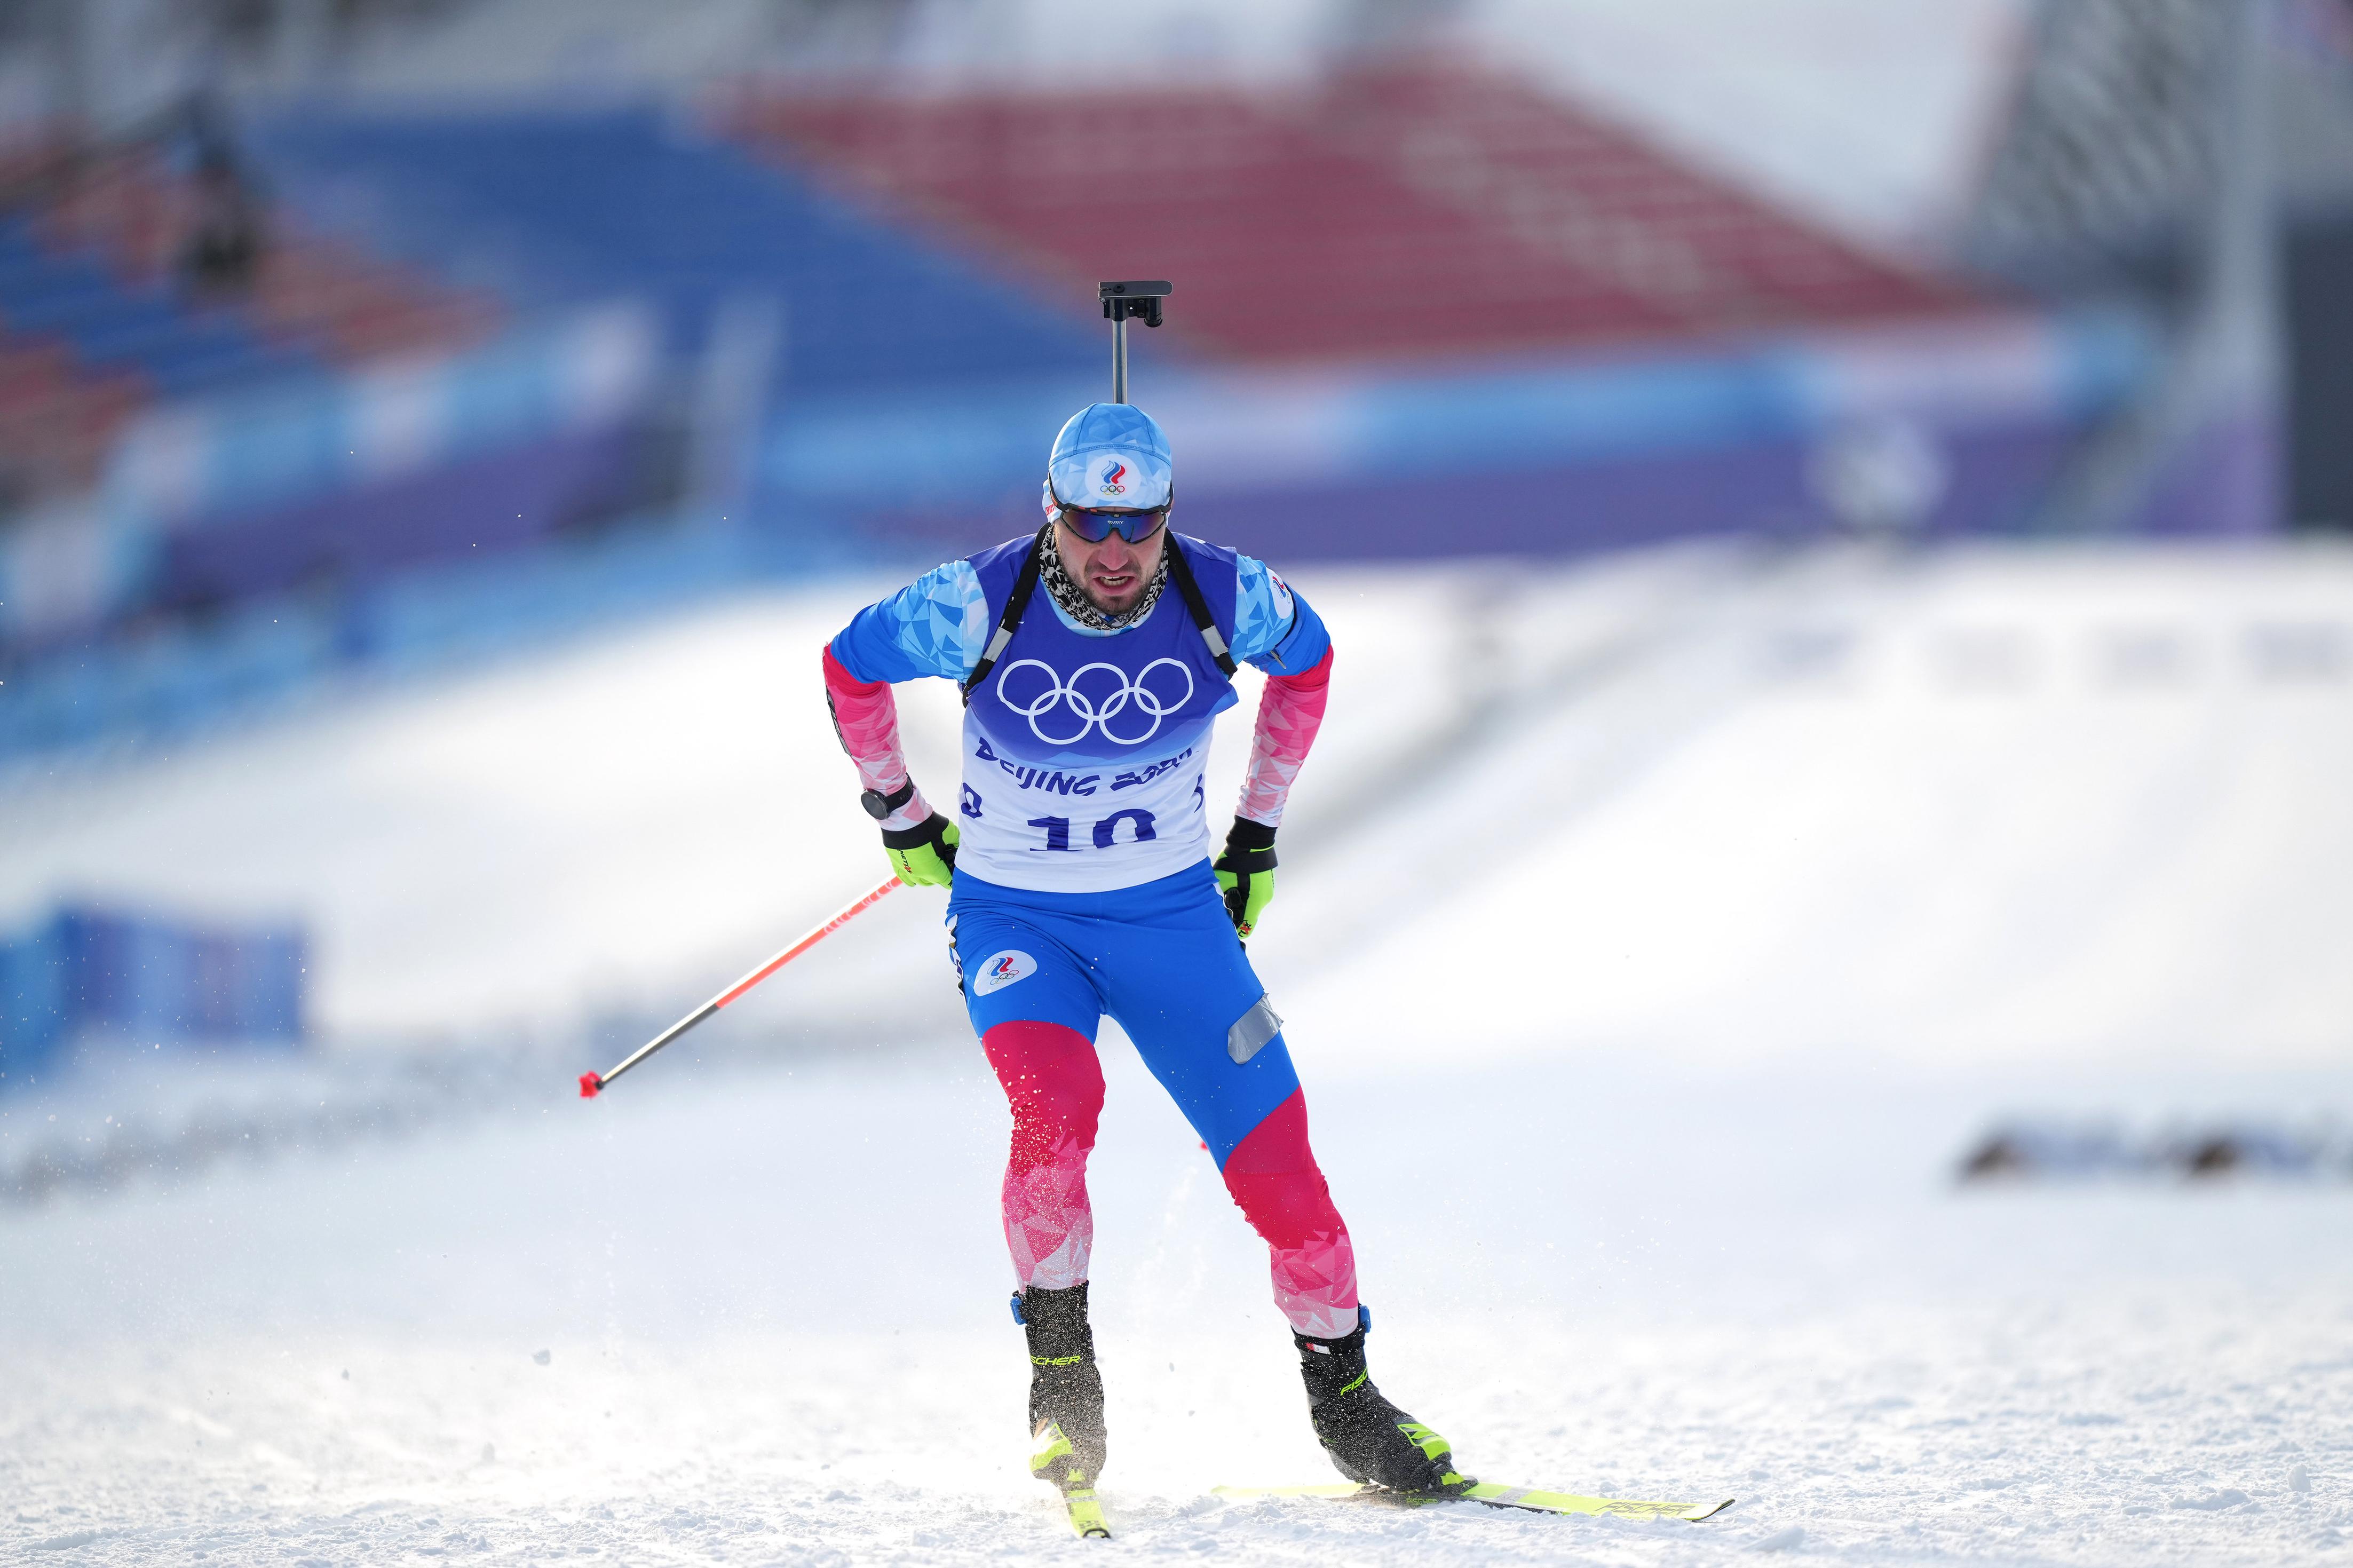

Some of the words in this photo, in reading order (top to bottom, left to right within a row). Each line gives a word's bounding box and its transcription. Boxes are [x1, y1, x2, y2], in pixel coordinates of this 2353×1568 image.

[1027, 808, 1157, 852] 10
[1030, 1355, 1081, 1366] SCHER
[1340, 1366, 1368, 1396] FISC
[1594, 1501, 1696, 1516] FISCHER
